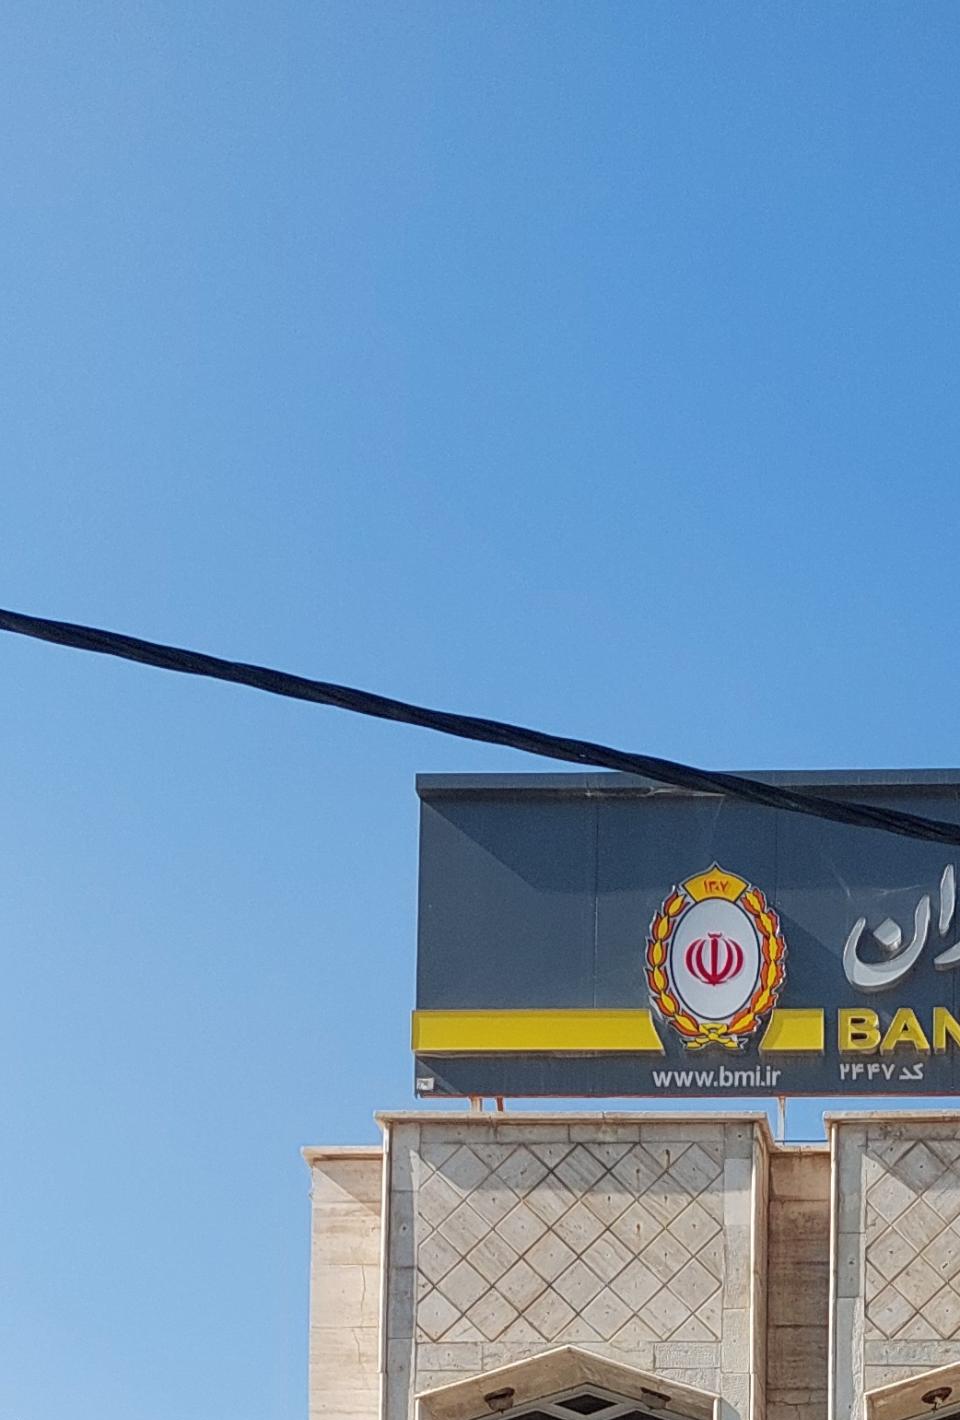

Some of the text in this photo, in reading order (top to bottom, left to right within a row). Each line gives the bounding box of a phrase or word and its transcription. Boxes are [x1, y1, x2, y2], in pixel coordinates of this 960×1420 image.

[652, 1065, 782, 1088] www.bmi.ir
[839, 1062, 925, 1081] کد ۲۴۴۷
